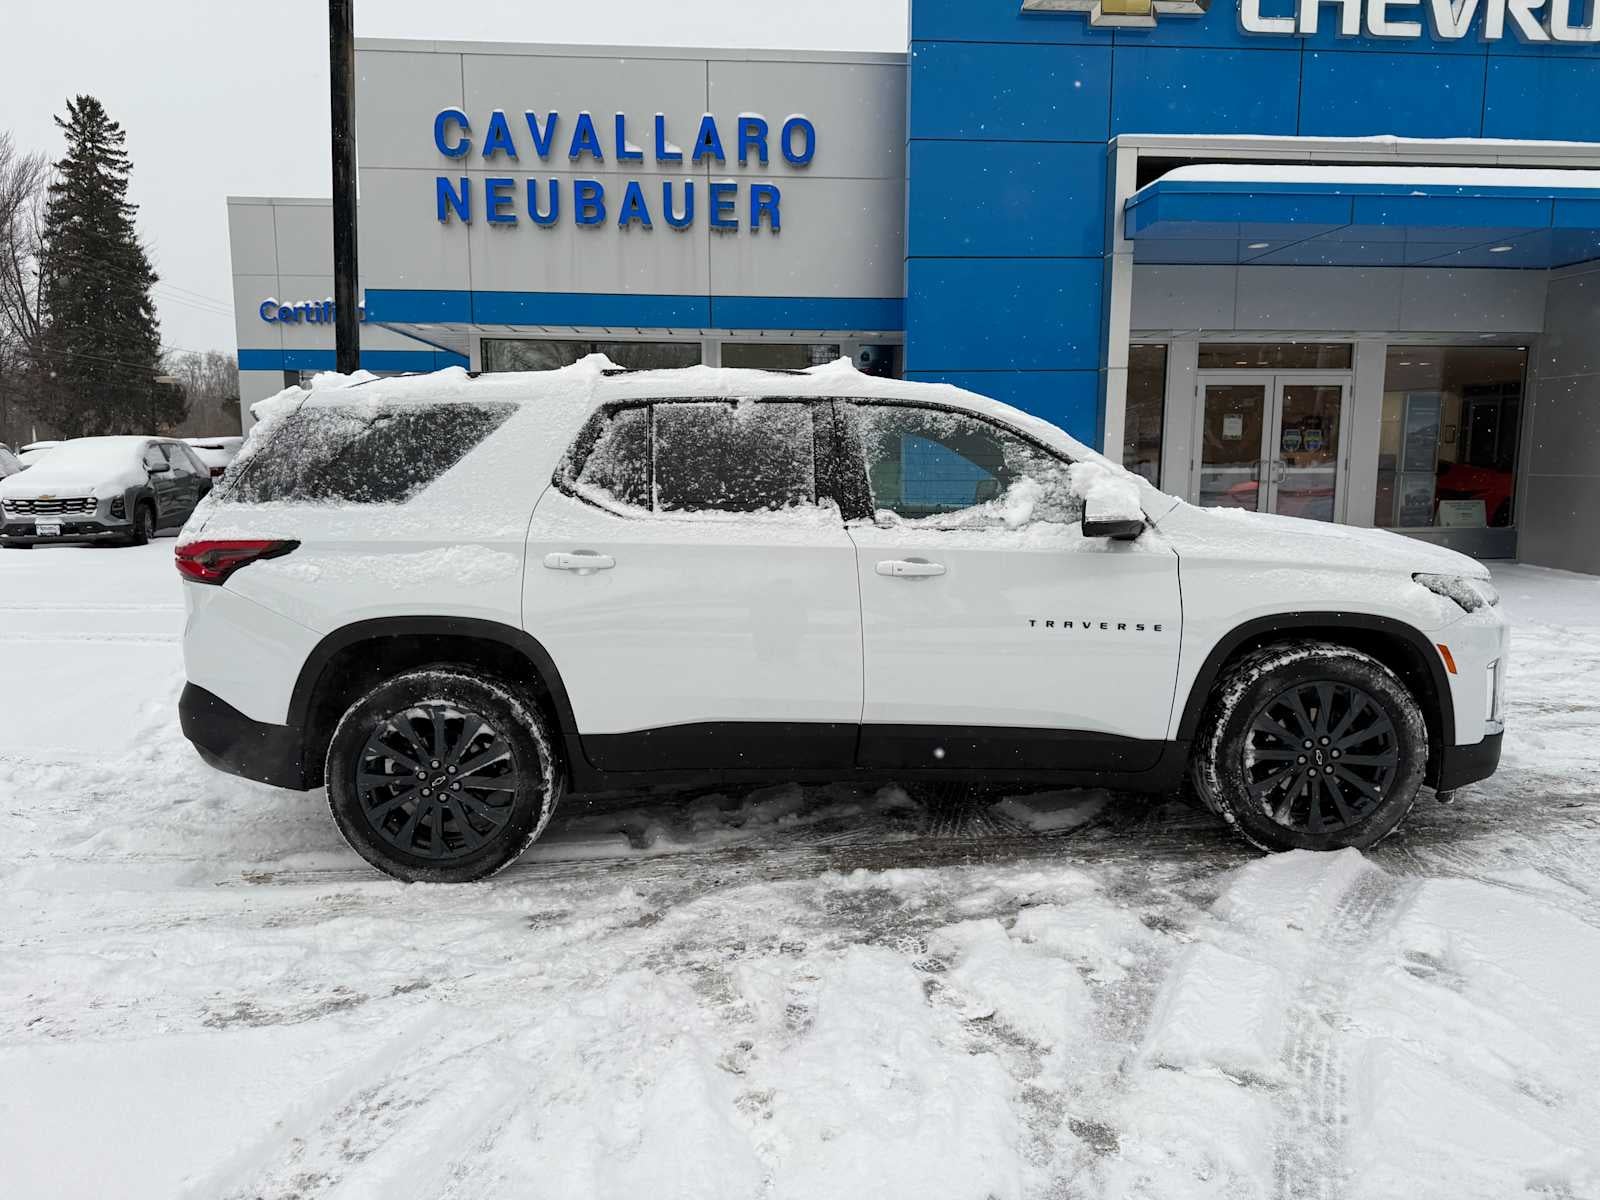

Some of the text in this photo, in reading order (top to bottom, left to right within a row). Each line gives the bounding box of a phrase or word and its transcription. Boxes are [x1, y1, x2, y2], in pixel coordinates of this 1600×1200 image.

[434, 108, 817, 166] CAVALLARO
[435, 176, 782, 232] NEUBAUER
[1028, 619, 1163, 632] TRAVERSE
